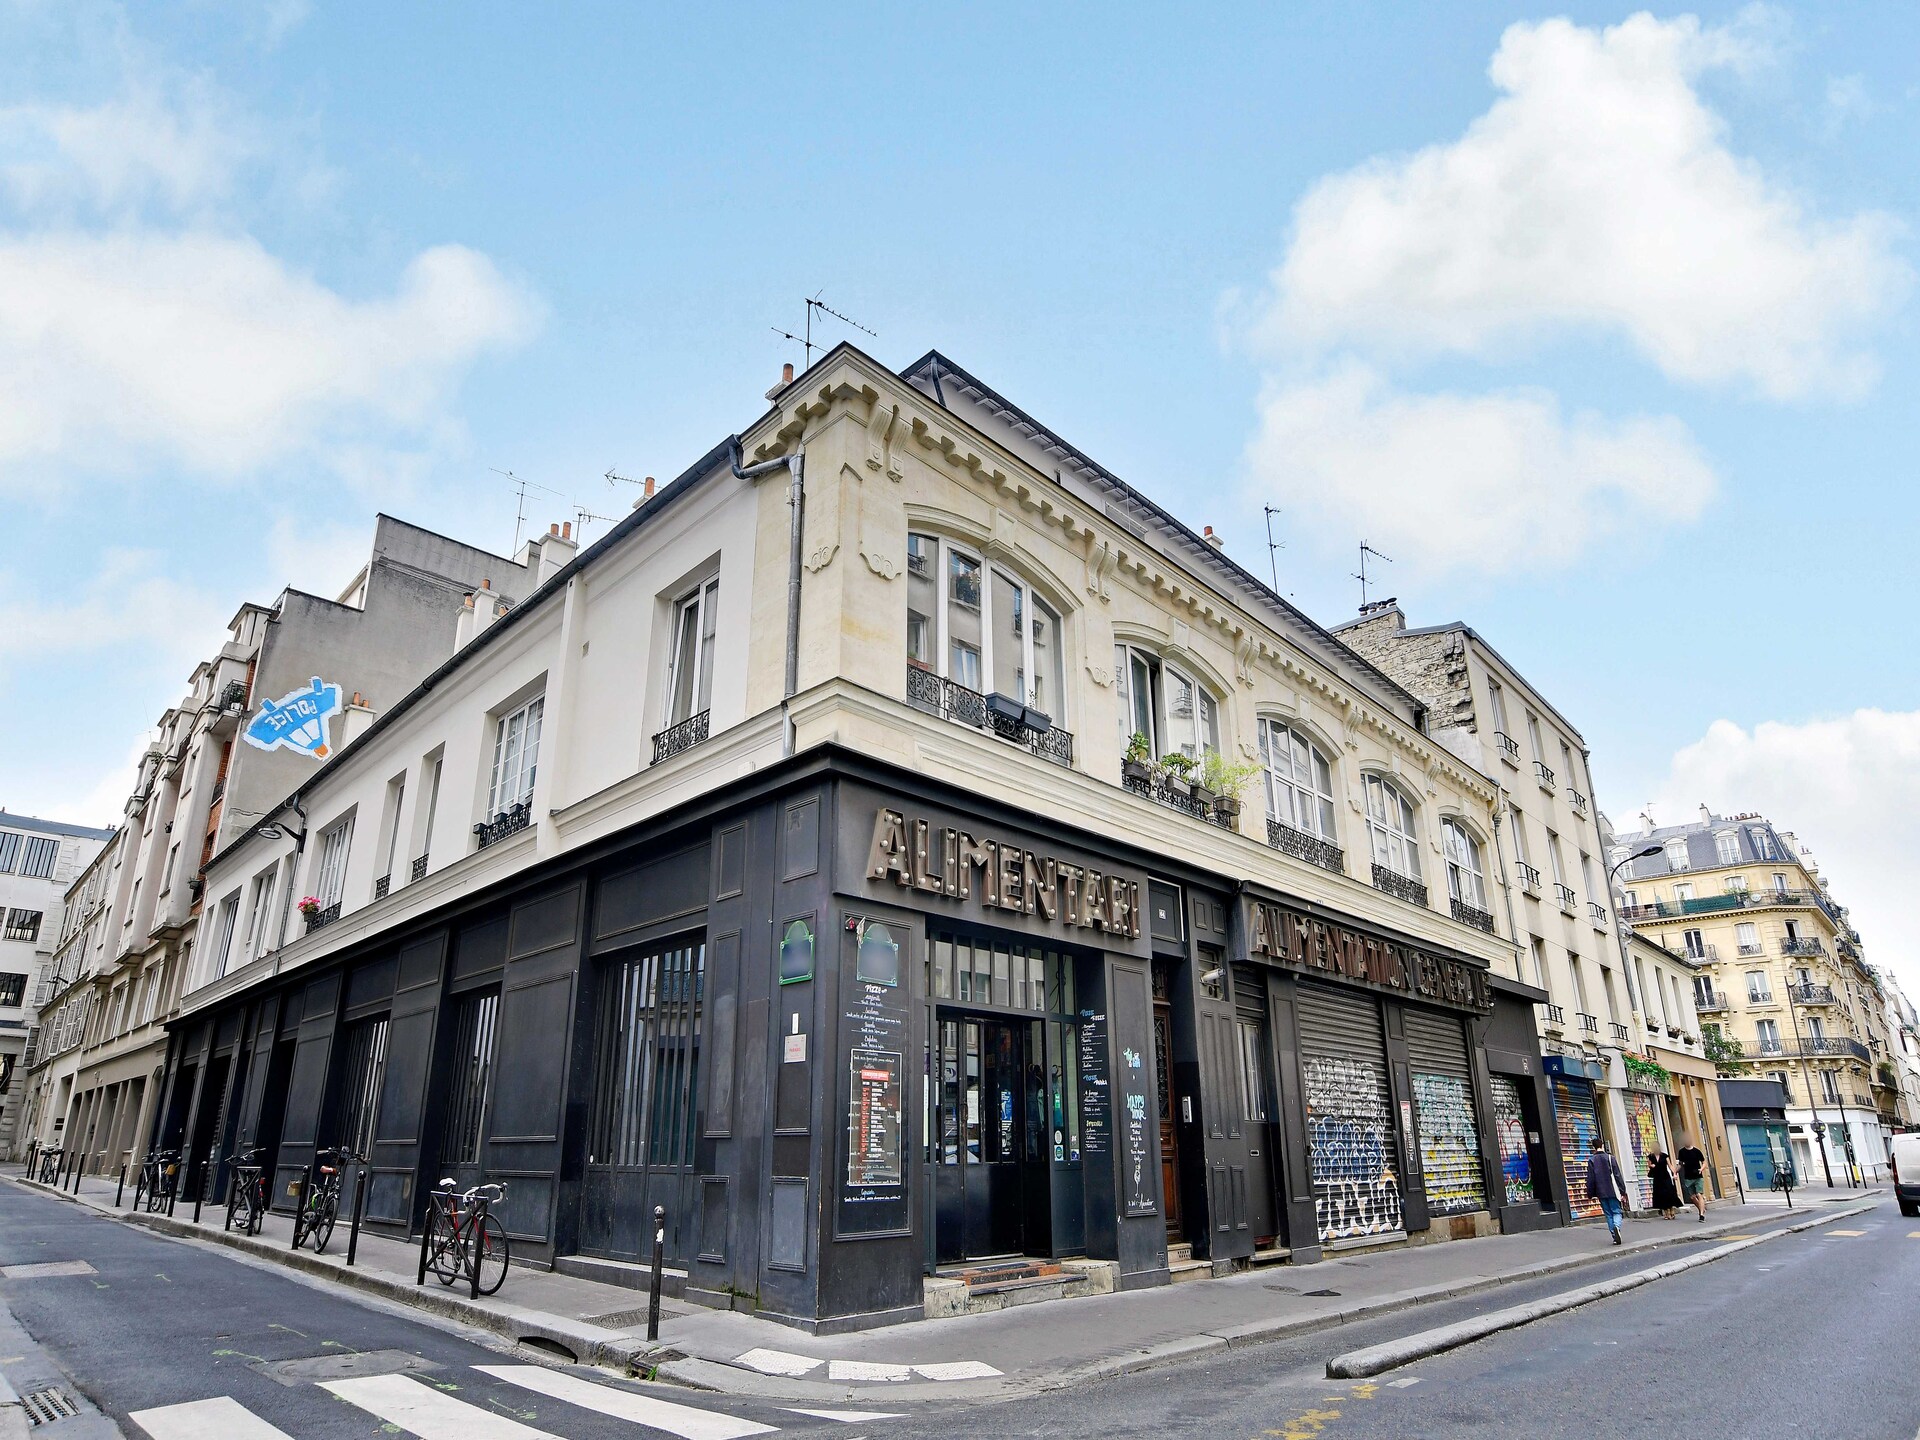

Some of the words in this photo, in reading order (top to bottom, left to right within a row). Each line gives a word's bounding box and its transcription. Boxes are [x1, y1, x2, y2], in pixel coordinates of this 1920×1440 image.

[264, 699, 317, 732] POLICE
[866, 807, 1141, 940] ALIMENTARI
[1250, 902, 1411, 990] ALIMENTATION
